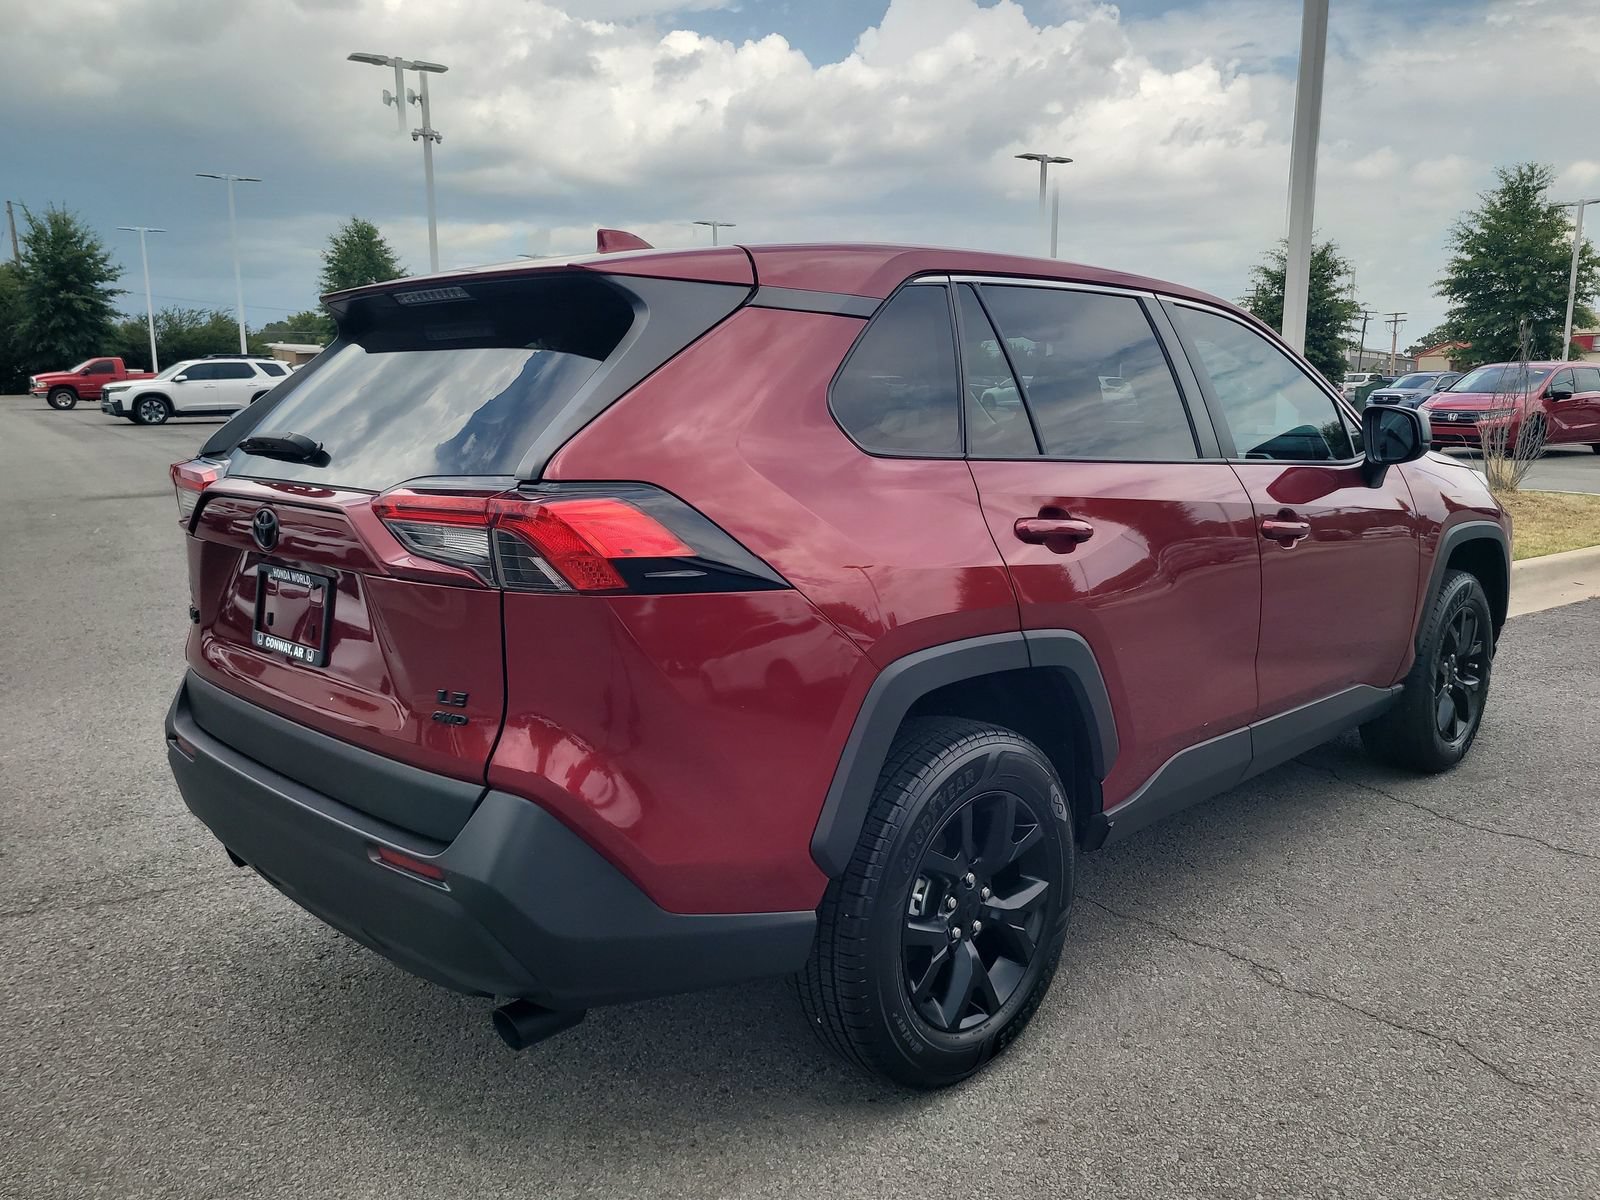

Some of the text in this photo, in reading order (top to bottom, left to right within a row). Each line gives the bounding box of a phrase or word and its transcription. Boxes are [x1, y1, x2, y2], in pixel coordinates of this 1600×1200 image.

[272, 567, 311, 586] HONDA WORLD
[265, 637, 304, 658] CONWAY, AR
[437, 689, 468, 707] LE
[432, 710, 468, 725] AWD
